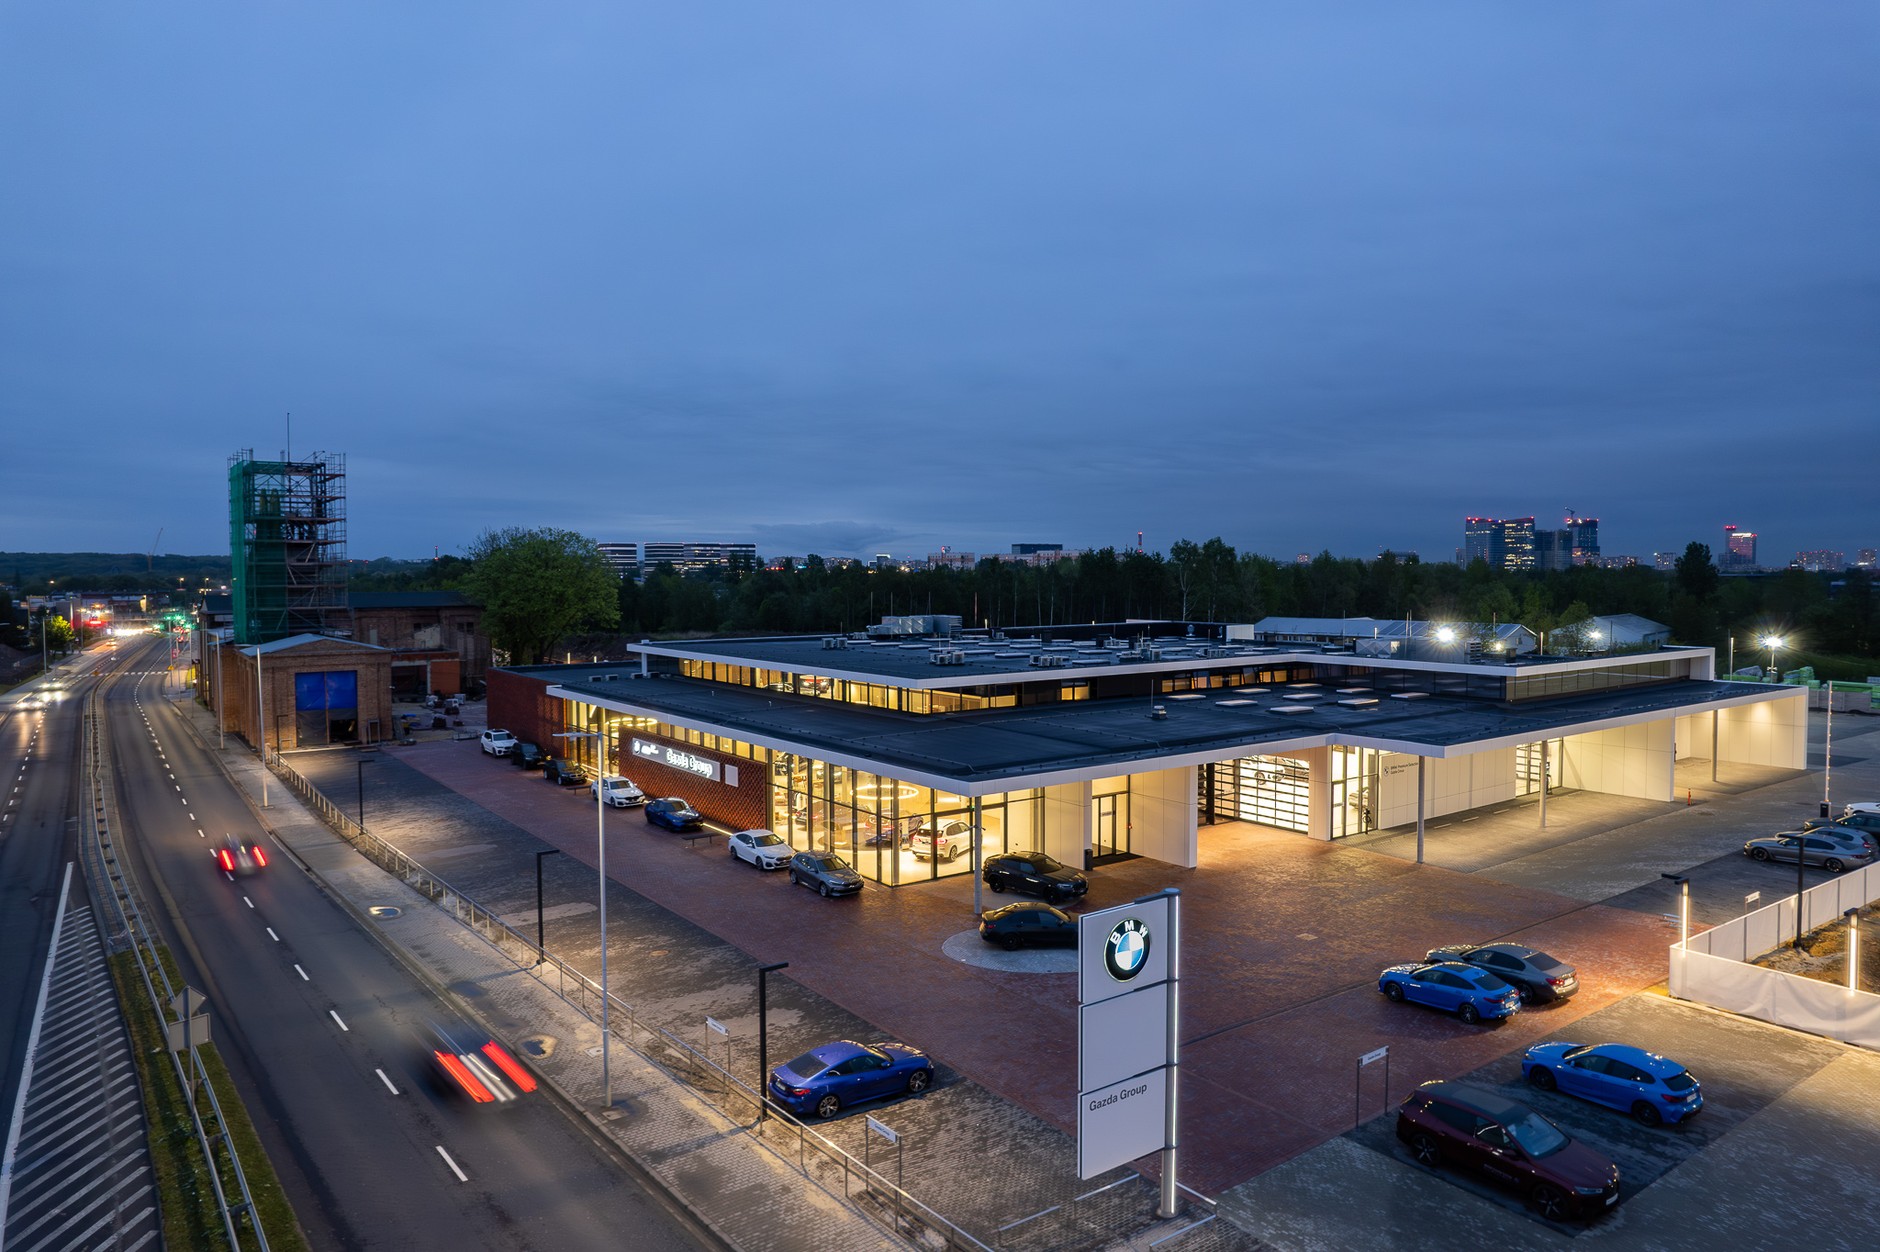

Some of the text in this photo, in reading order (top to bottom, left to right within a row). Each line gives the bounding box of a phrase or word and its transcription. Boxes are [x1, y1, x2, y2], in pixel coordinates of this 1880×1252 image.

[1110, 920, 1148, 945] BMW
[1089, 1084, 1147, 1111] Gazda Group
